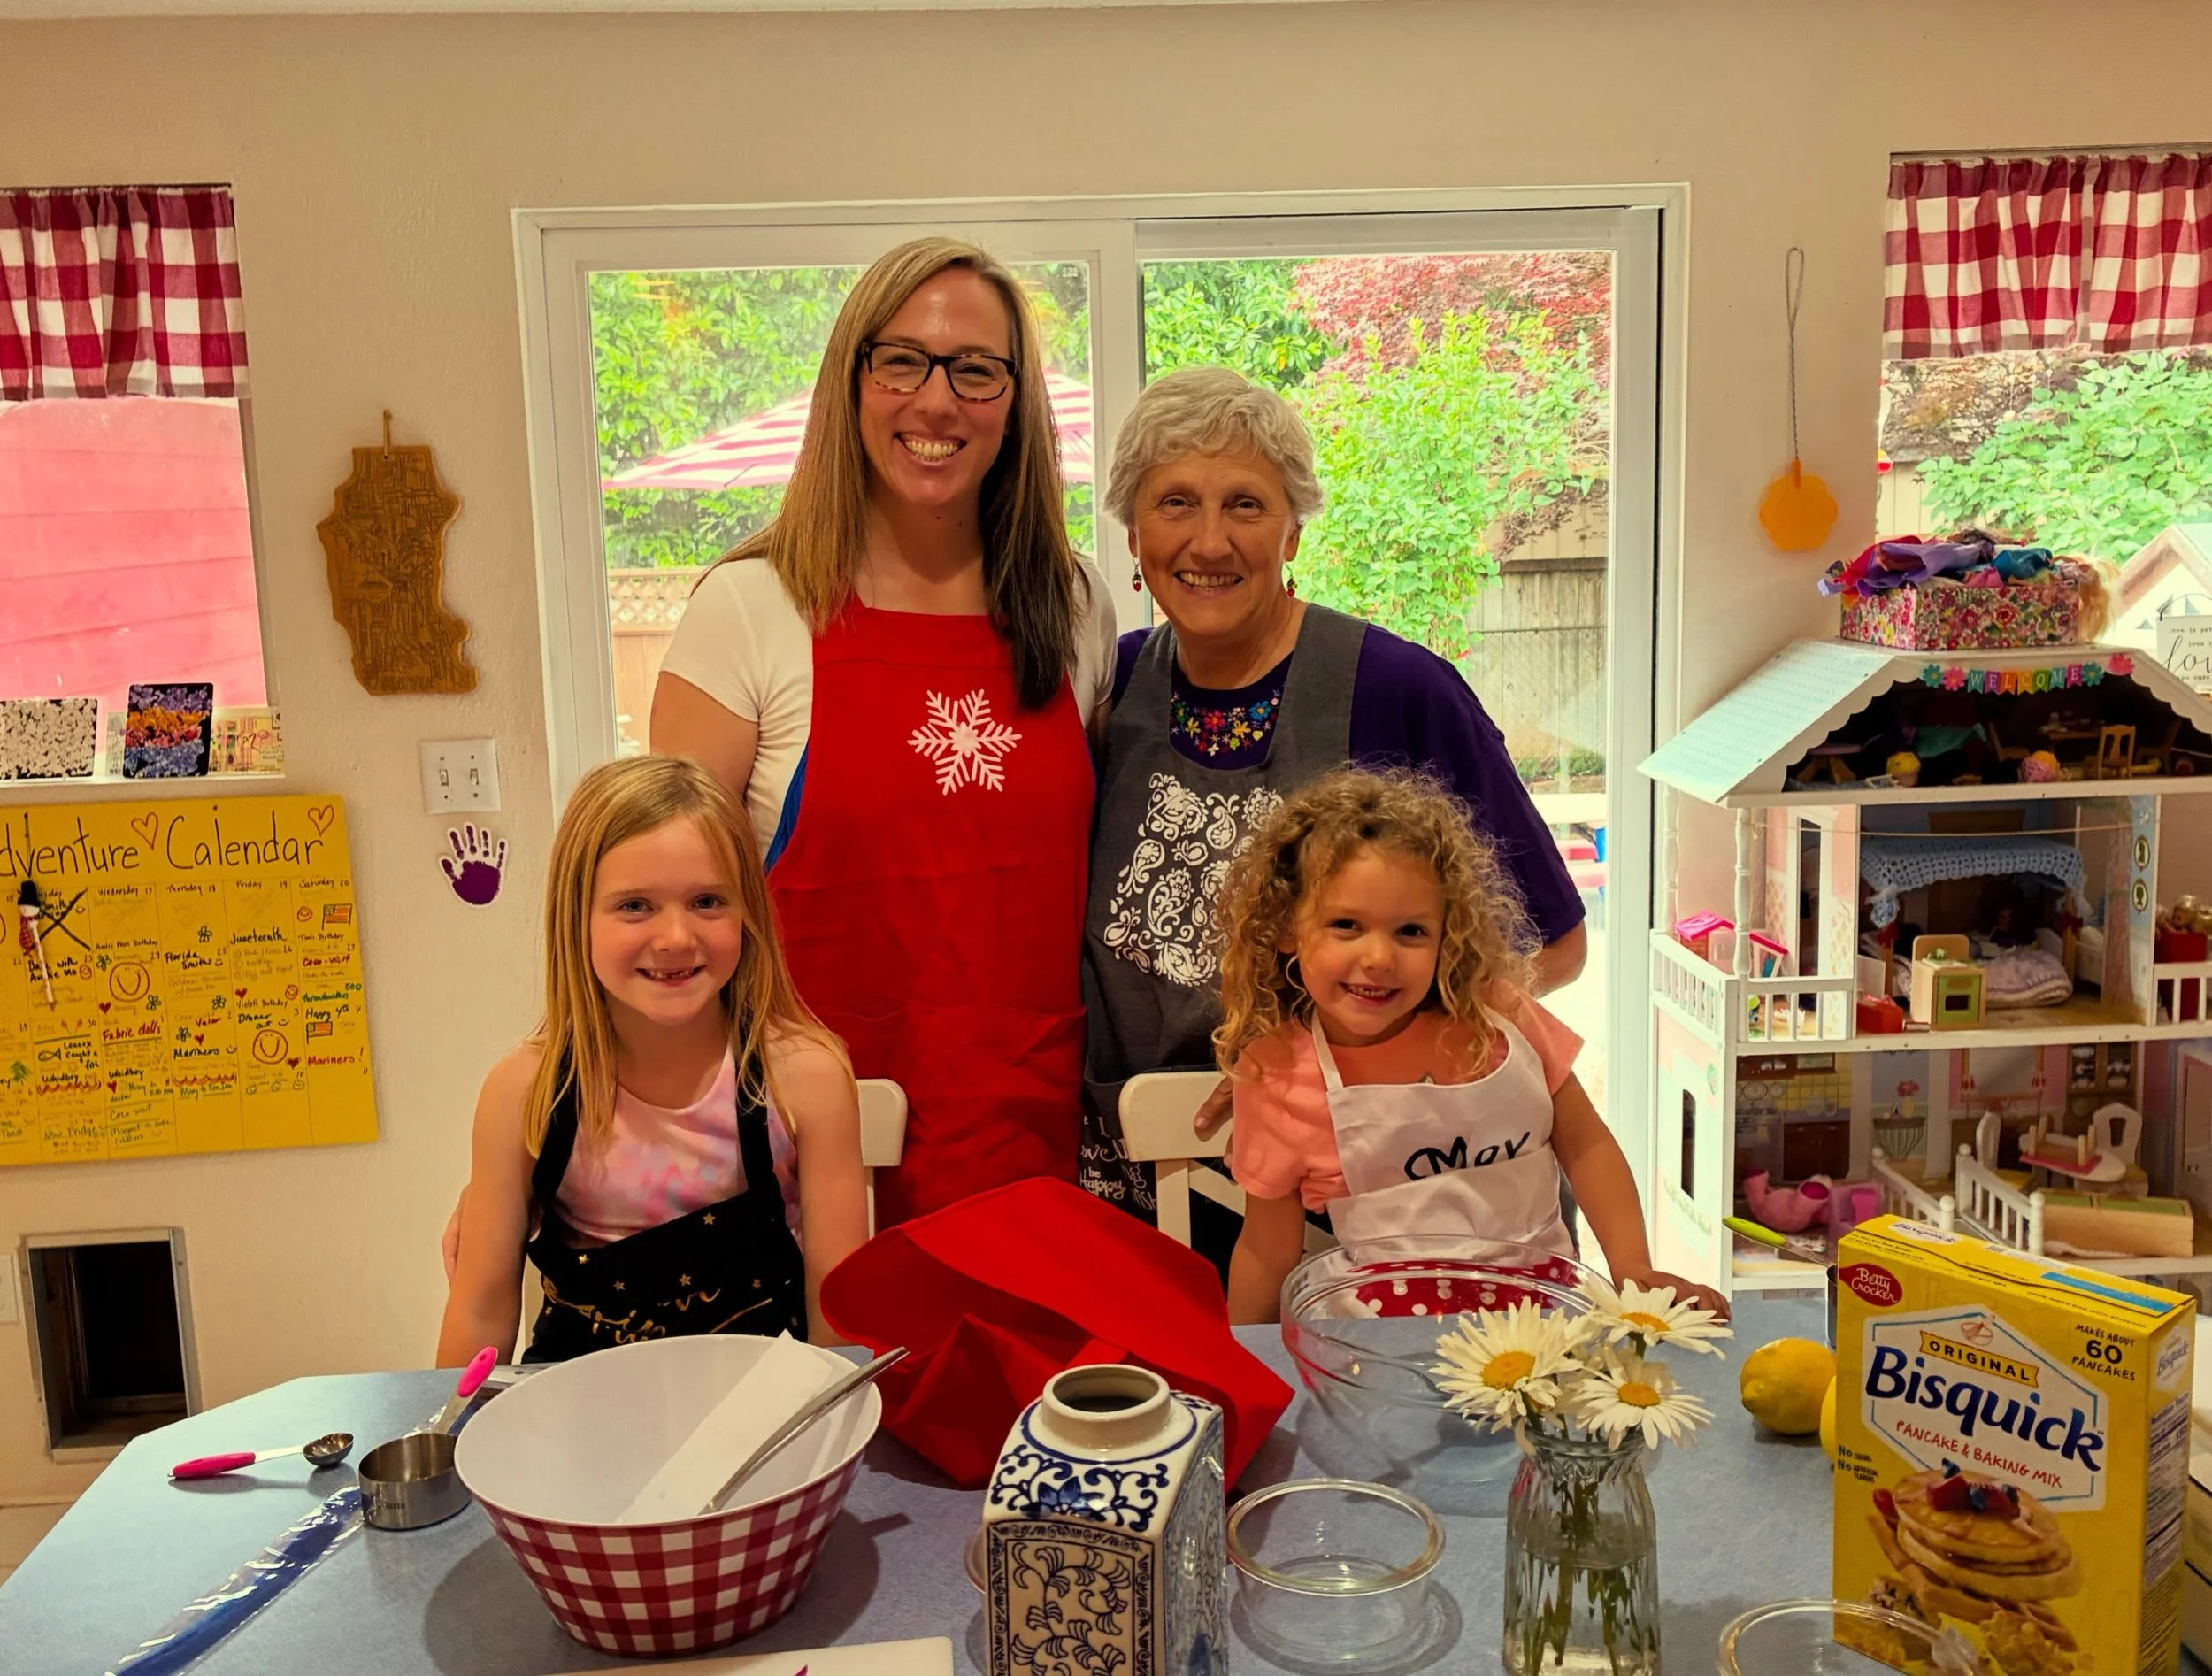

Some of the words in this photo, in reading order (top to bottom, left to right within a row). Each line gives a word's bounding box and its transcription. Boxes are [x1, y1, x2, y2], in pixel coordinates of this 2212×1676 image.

[1970, 668, 2080, 688] WELCOME
[0, 811, 140, 879] dventure
[167, 804, 324, 870] Calendar
[235, 880, 263, 890] Friday
[299, 879, 335, 889] Saturday
[230, 925, 287, 945] Juneteenth
[164, 949, 198, 965] Florida
[306, 1007, 332, 1023] Happy
[103, 1026, 134, 1042] Fabric
[138, 1019, 161, 1035] dolls
[1088, 1166, 1102, 1179] be
[1079, 1168, 1125, 1201] Happy
[1851, 1277, 1898, 1303] Crocker
[1855, 1267, 1892, 1291] Betty
[2075, 1323, 2105, 1339] MAKES
[2106, 1332, 2135, 1347] ABOUT
[1929, 1339, 2033, 1382] ORIGINAL
[2085, 1339, 2123, 1365] 60
[2071, 1356, 2136, 1381] PANCAKES
[1865, 1346, 2104, 1472] Bisquick
[1839, 1443, 1854, 1457] No
[1895, 1419, 1959, 1454] PANCAKE
[1962, 1443, 1971, 1458] &
[1974, 1448, 2030, 1478] BAKING
[2032, 1470, 2063, 1489] MIX
[1837, 1457, 1853, 1472] No
